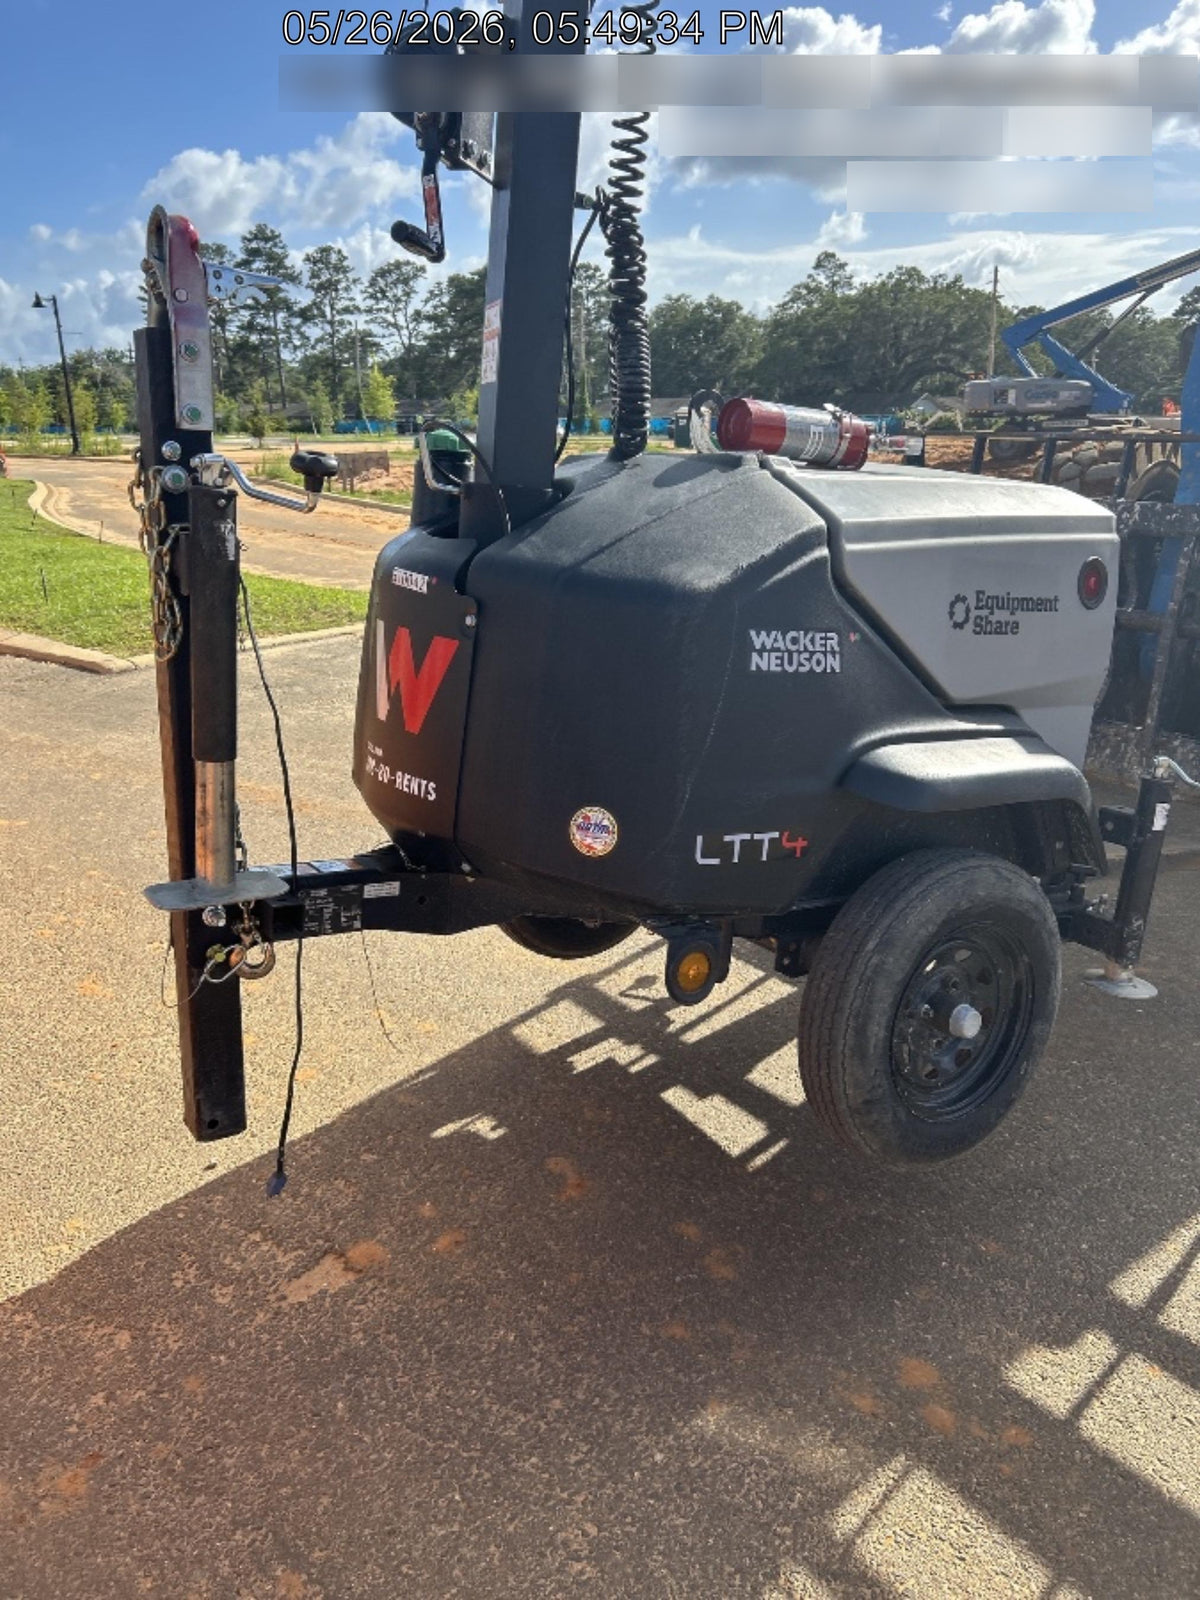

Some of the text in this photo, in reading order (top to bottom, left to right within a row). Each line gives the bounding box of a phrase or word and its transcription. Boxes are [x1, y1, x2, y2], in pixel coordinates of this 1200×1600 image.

[973, 590, 1059, 614] Equipment
[972, 614, 1020, 636] Share
[749, 629, 841, 651] WACKER
[750, 651, 841, 673] NEUSON
[695, 831, 808, 865] LTT4
